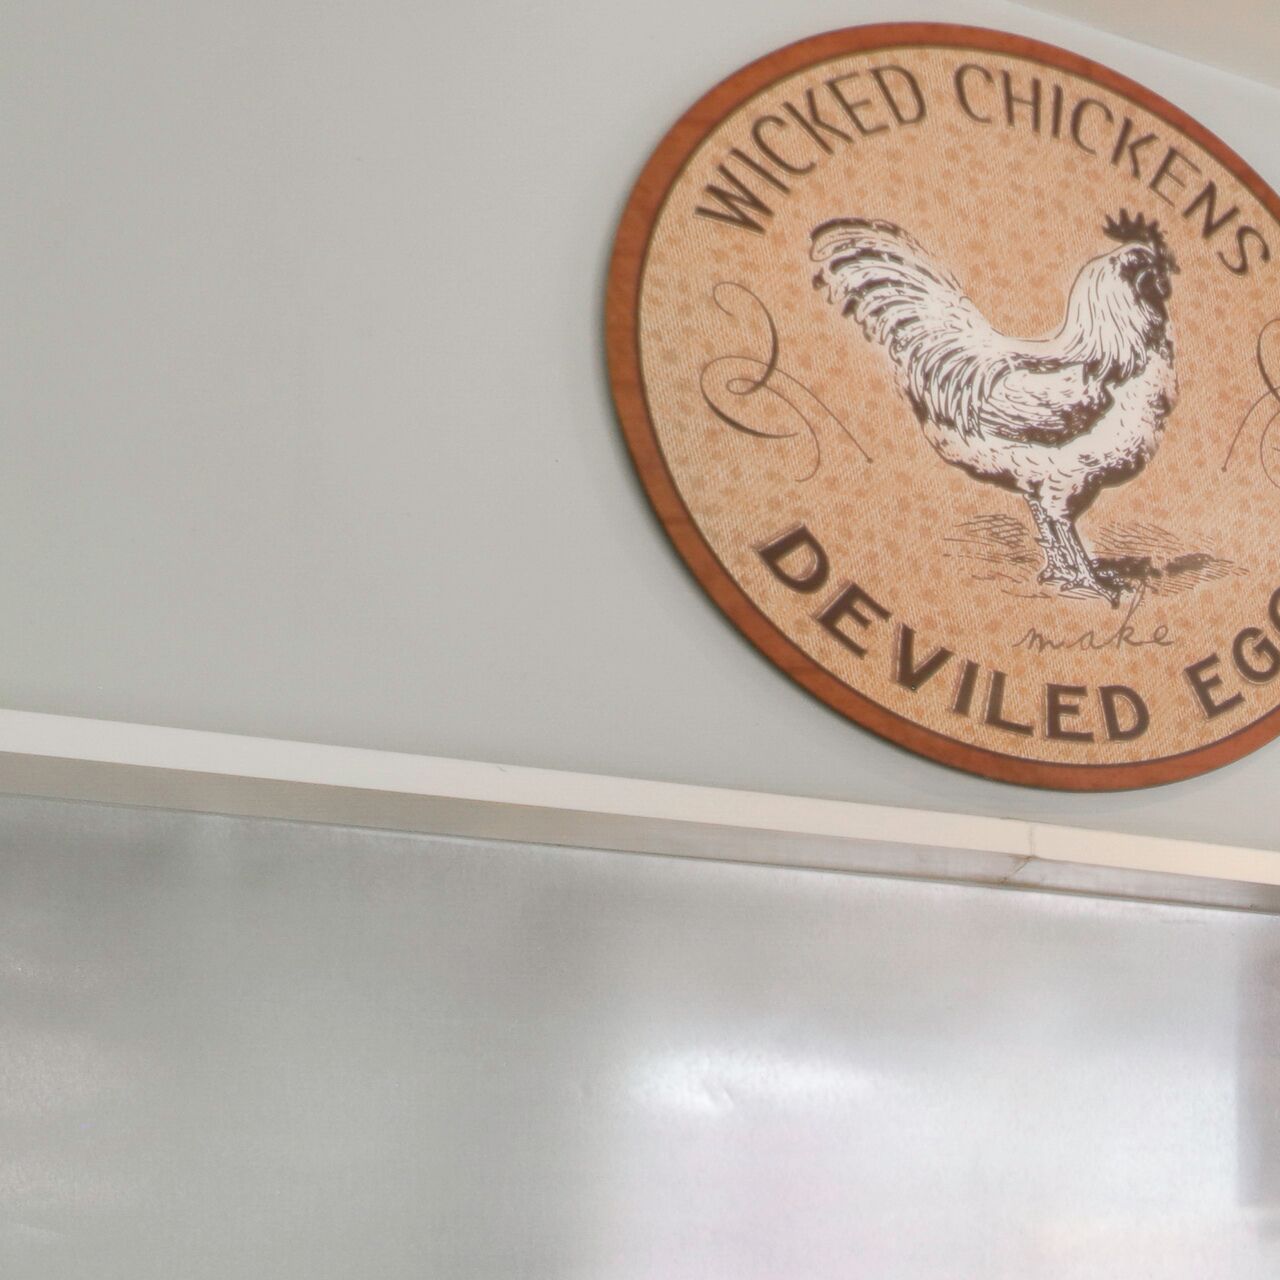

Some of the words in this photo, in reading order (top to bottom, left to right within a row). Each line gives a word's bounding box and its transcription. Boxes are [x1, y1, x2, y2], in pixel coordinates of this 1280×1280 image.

[694, 63, 928, 235] WICKED
[953, 62, 1272, 277] CHICKENS
[753, 525, 1151, 744] DEVILED
